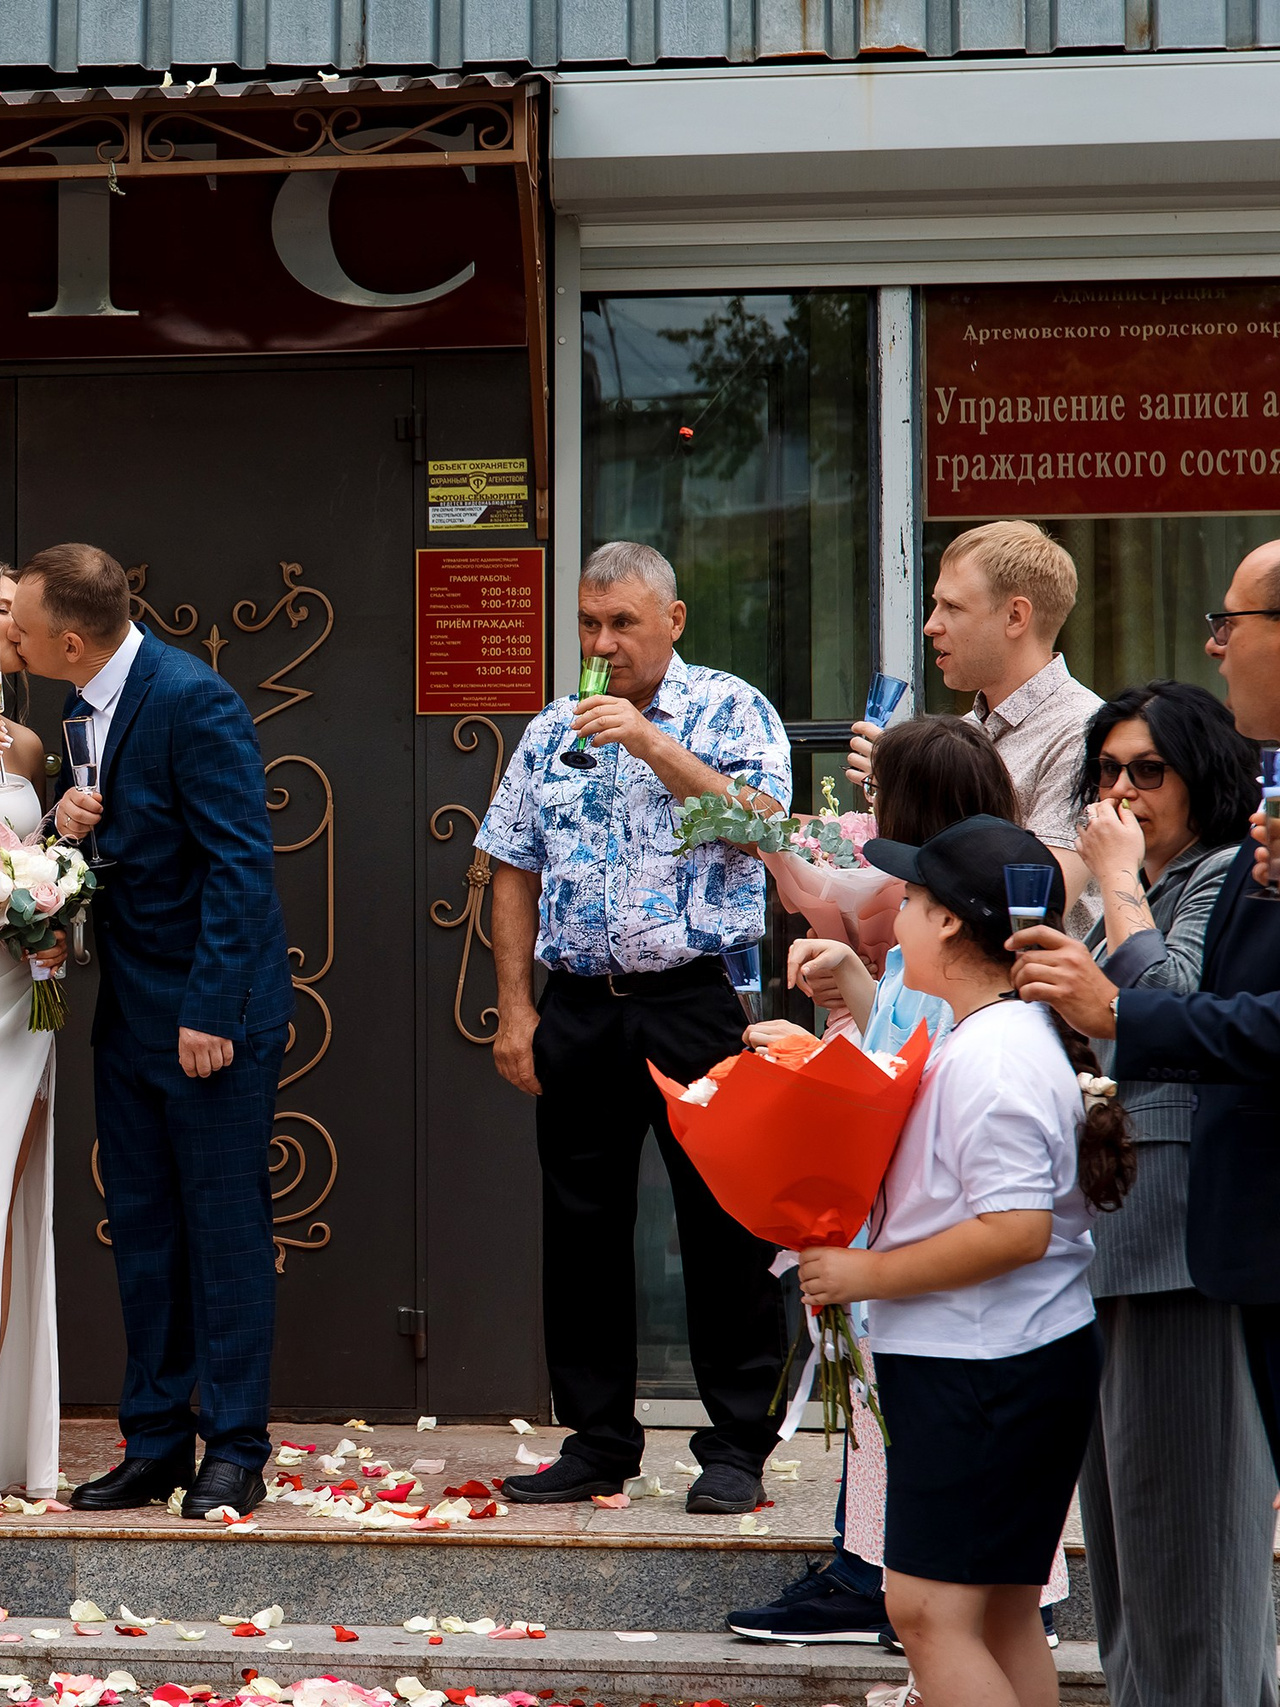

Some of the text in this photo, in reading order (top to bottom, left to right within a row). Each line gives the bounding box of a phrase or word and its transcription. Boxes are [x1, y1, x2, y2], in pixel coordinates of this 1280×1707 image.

[962, 324, 1111, 344] Артемовского
[1119, 321, 1238, 341] городского
[934, 387, 1126, 435] Управление
[1138, 390, 1249, 421] записи
[433, 462, 525, 471] ОБЪЕКТ ОХРАНЯЕТСЯ
[935, 450, 1166, 492] гражданского
[430, 476, 468, 485] ОХРАННЫМ
[488, 475, 525, 483] АГЕНТСТВОМ
[481, 587, 531, 596] 9:00-18:00
[481, 599, 531, 608] 9:00-17:00
[436, 618, 524, 629] ПРИЁМ ГРАЖДАН:
[481, 635, 531, 644] 9:00-16:00
[481, 647, 531, 656] 9:00-13:00
[476, 666, 531, 675] 13:00-14:00
